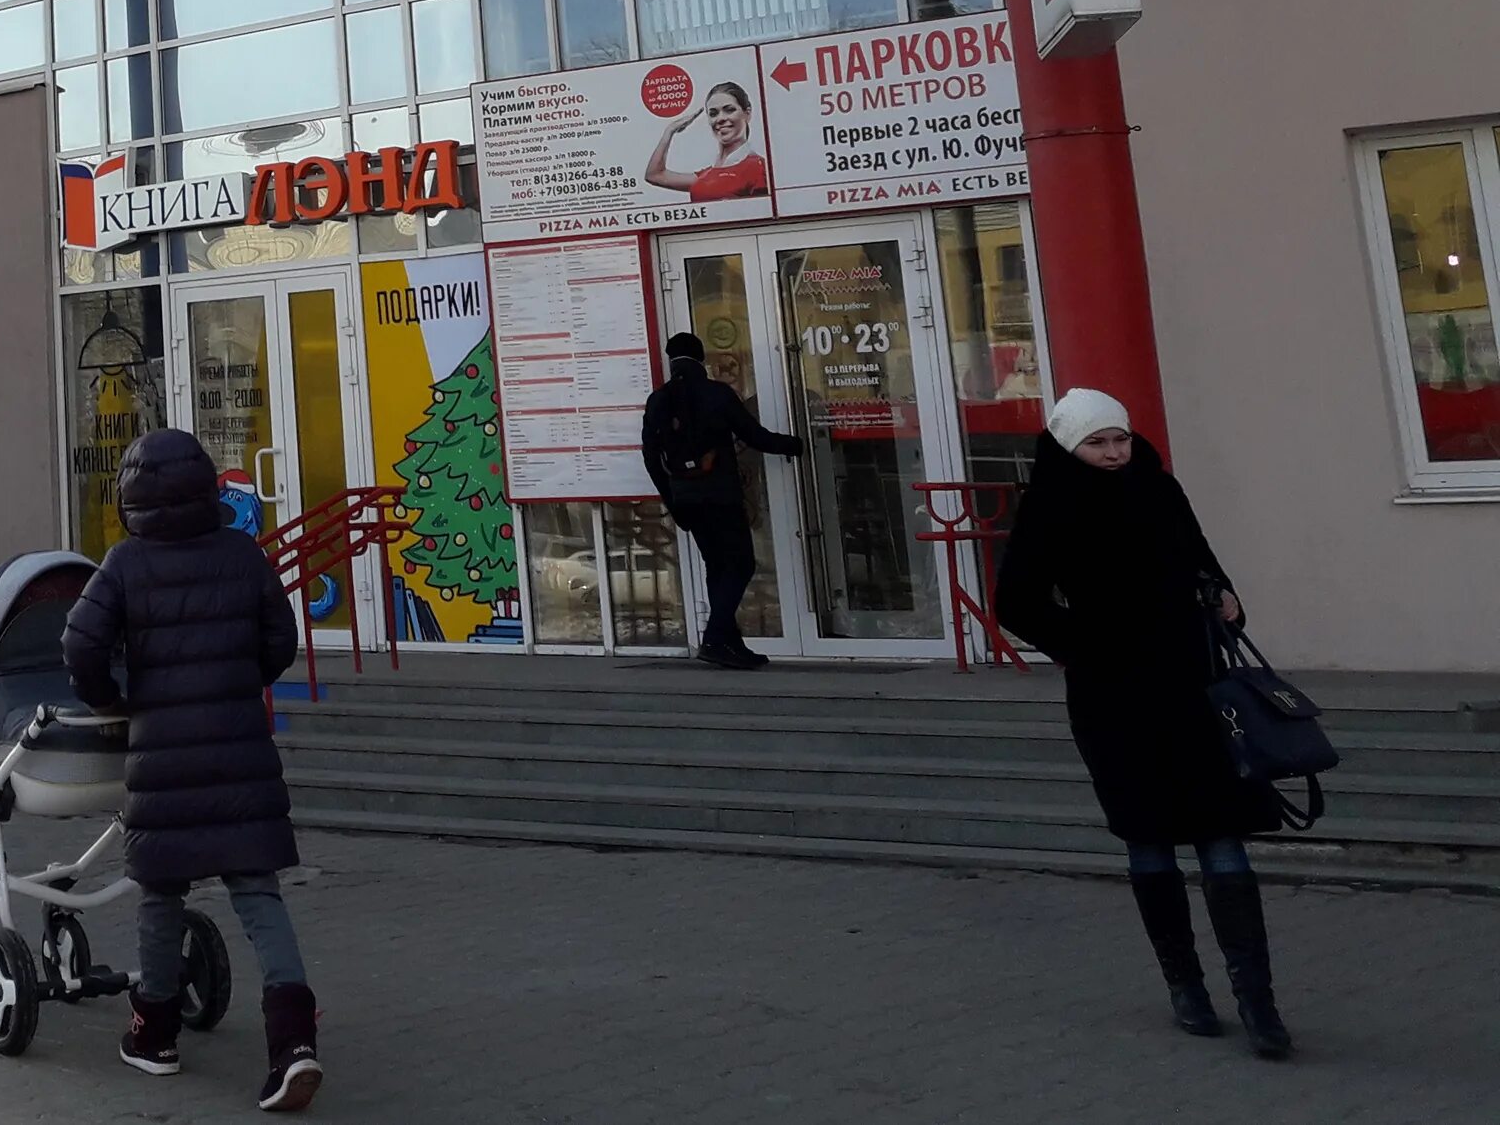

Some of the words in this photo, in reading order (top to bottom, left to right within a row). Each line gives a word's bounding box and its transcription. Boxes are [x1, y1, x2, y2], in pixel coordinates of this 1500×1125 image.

[815, 21, 1012, 86] ПАРКОВК
[645, 75, 688, 86] ЗАРПЛАТА
[657, 83, 686, 92] 18000
[480, 90, 515, 102] Учим
[518, 83, 571, 97] быстро.
[656, 92, 688, 100] 40000
[820, 91, 853, 115] 50
[862, 73, 987, 111] МЕТРОВ
[482, 101, 535, 116] Кормим
[538, 95, 588, 109] вкусно.
[483, 114, 532, 129] Платим
[535, 108, 585, 122] честно.
[484, 126, 528, 139] Заведующий
[529, 121, 585, 133] производством
[599, 116, 621, 125] 35000
[822, 123, 903, 147] Первые
[908, 117, 920, 135] 2
[924, 114, 972, 133] часа
[977, 107, 1022, 126] бесп
[567, 150, 589, 159] 18000
[825, 151, 887, 173] Заезд
[892, 149, 902, 165] с
[905, 146, 937, 169] ул.
[942, 138, 970, 160] Ю.
[974, 134, 1026, 160] Фуч
[510, 178, 532, 188] тел:
[533, 167, 624, 185] 8(343)266-43-88
[511, 189, 537, 200] моб:
[539, 178, 637, 197] +7(903)086-43-88
[827, 186, 890, 205] PIZZA
[897, 180, 942, 199] MIA
[952, 175, 999, 192] ЕСТЬ
[539, 219, 583, 233] PIZZA
[588, 216, 620, 230] MIA
[627, 211, 660, 225] ЕСТЬ
[665, 207, 708, 222] ВЕЗДЕ
[803, 268, 847, 282] PIZZA
[849, 266, 882, 279] MIA
[376, 279, 482, 326] ПОДАРКИ!
[824, 365, 838, 374] БЕЗ
[839, 363, 880, 373] ПЕРЕРЫВА
[835, 376, 880, 386] ВЫХОДНЫХ
[95, 412, 140, 441] КНИГИ
[73, 445, 127, 475] КАНЦЕ
[100, 478, 117, 506] ИГ
